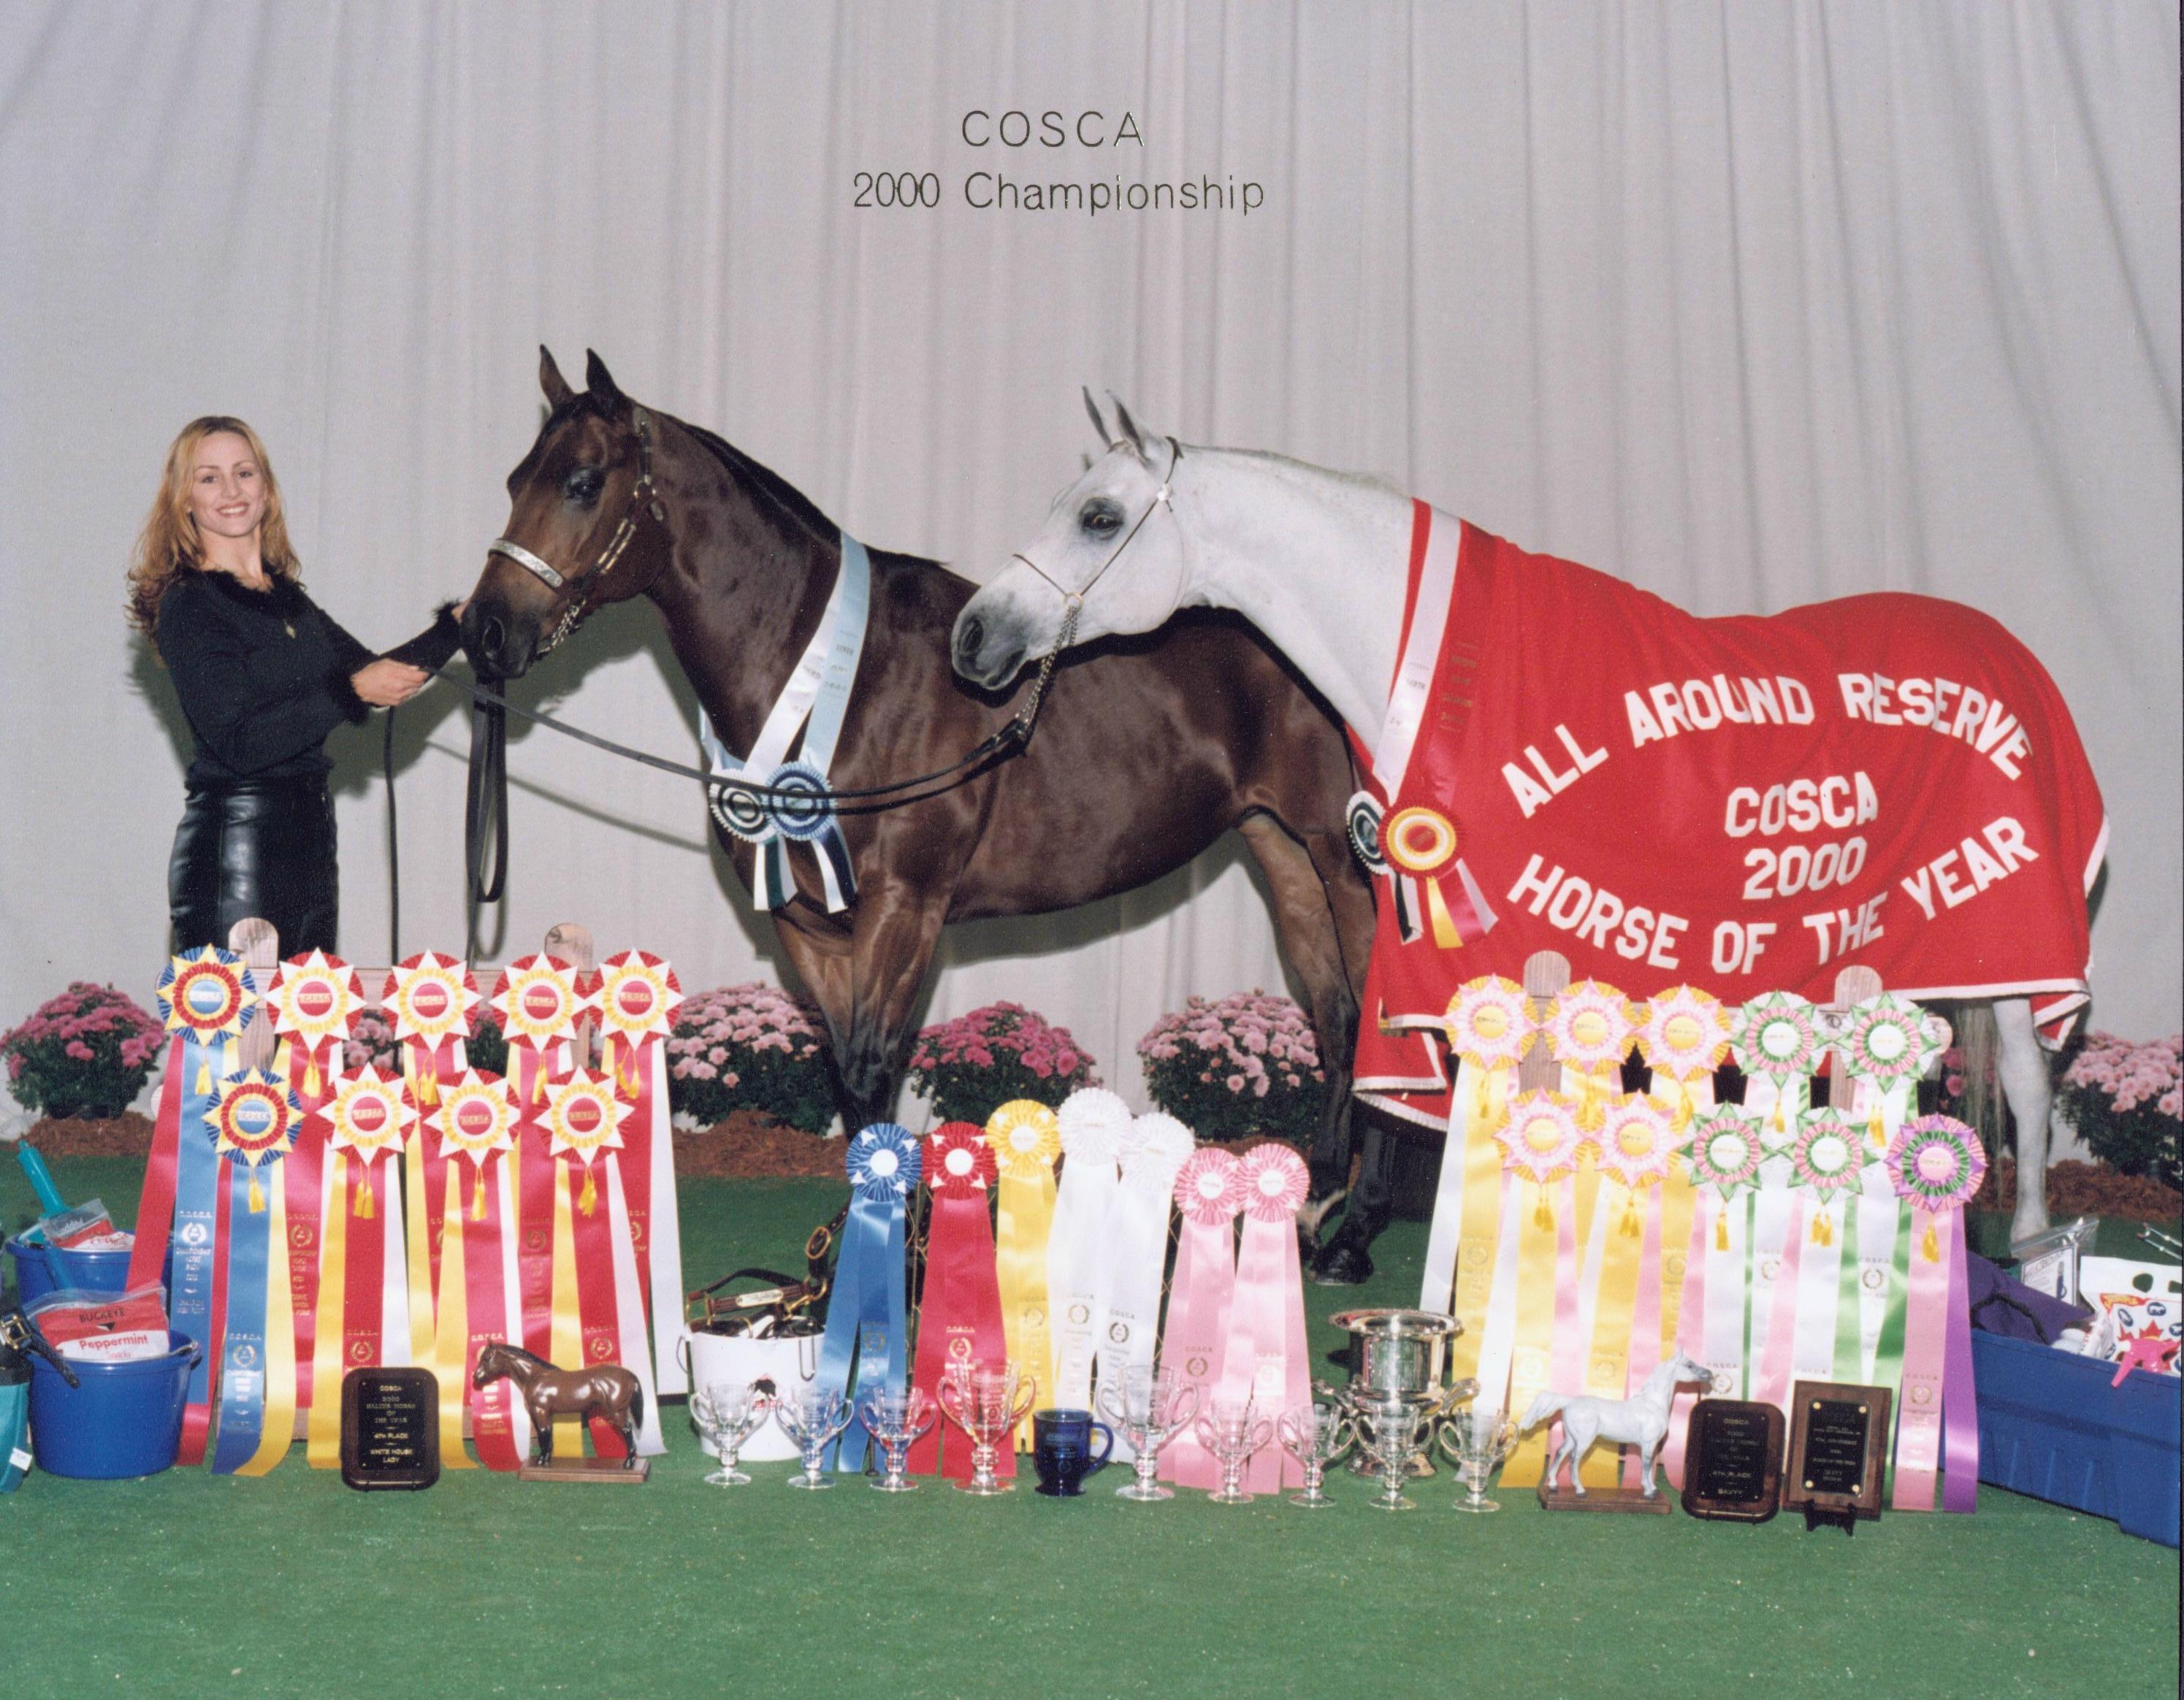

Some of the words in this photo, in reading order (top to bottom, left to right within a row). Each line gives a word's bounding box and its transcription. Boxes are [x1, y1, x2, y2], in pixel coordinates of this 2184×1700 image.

[1501, 724, 1609, 819] ALL
[1624, 673, 1815, 748] AROUND
[1839, 673, 2033, 781] RESERVE
[1725, 771, 1878, 838] COSCA
[1506, 854, 1689, 970] HORSE
[1711, 921, 1777, 974] OF
[1803, 892, 1888, 964] THE
[1901, 816, 2039, 920] YEAR
[1742, 837, 1868, 900] 2000
[79, 1307, 125, 1322] BUCKEYE
[79, 1333, 148, 1349] Peppermint
